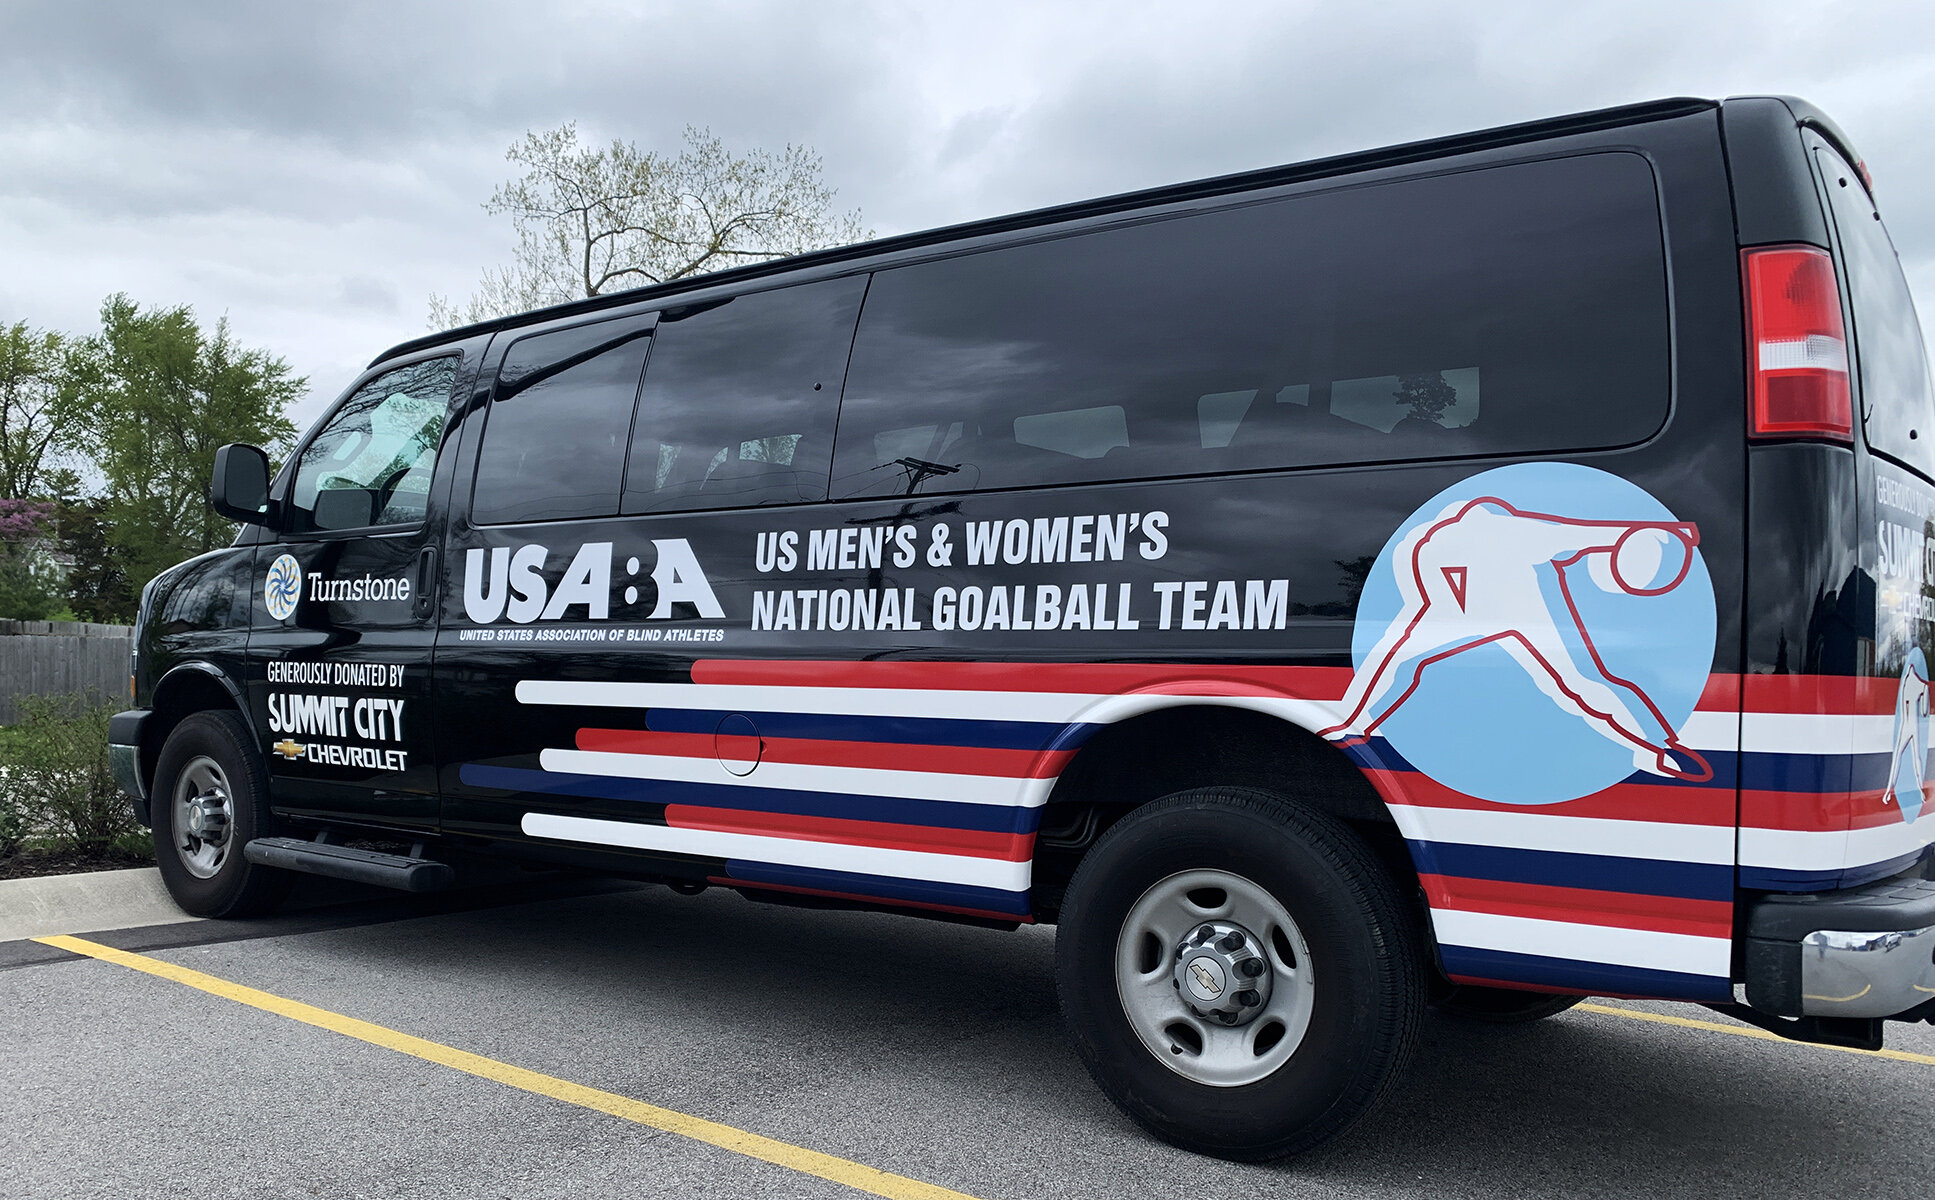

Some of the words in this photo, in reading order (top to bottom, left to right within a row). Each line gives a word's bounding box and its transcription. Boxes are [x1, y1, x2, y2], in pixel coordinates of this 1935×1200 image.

[755, 530, 799, 573] US
[807, 525, 917, 571] MEN'S
[927, 522, 954, 568] &
[965, 510, 1170, 566] WOMEN'S
[307, 572, 411, 602] Turnstone
[751, 587, 922, 632] NATIONAL
[932, 582, 1141, 631] GOALBALL
[1153, 579, 1290, 630] TEAM
[459, 629, 495, 641] UNITED
[497, 629, 533, 641] STATES
[535, 629, 607, 642] ASSOCIATION
[608, 629, 625, 642] OF
[626, 629, 661, 642] BLIND
[663, 629, 725, 642] ATHLETES
[267, 661, 333, 685] GENEROUSLY
[334, 663, 387, 687] DONATED
[389, 664, 405, 688] BY
[268, 692, 349, 738] SUMMIT
[353, 698, 405, 742] CITY
[307, 743, 408, 771] CHEVROLET
